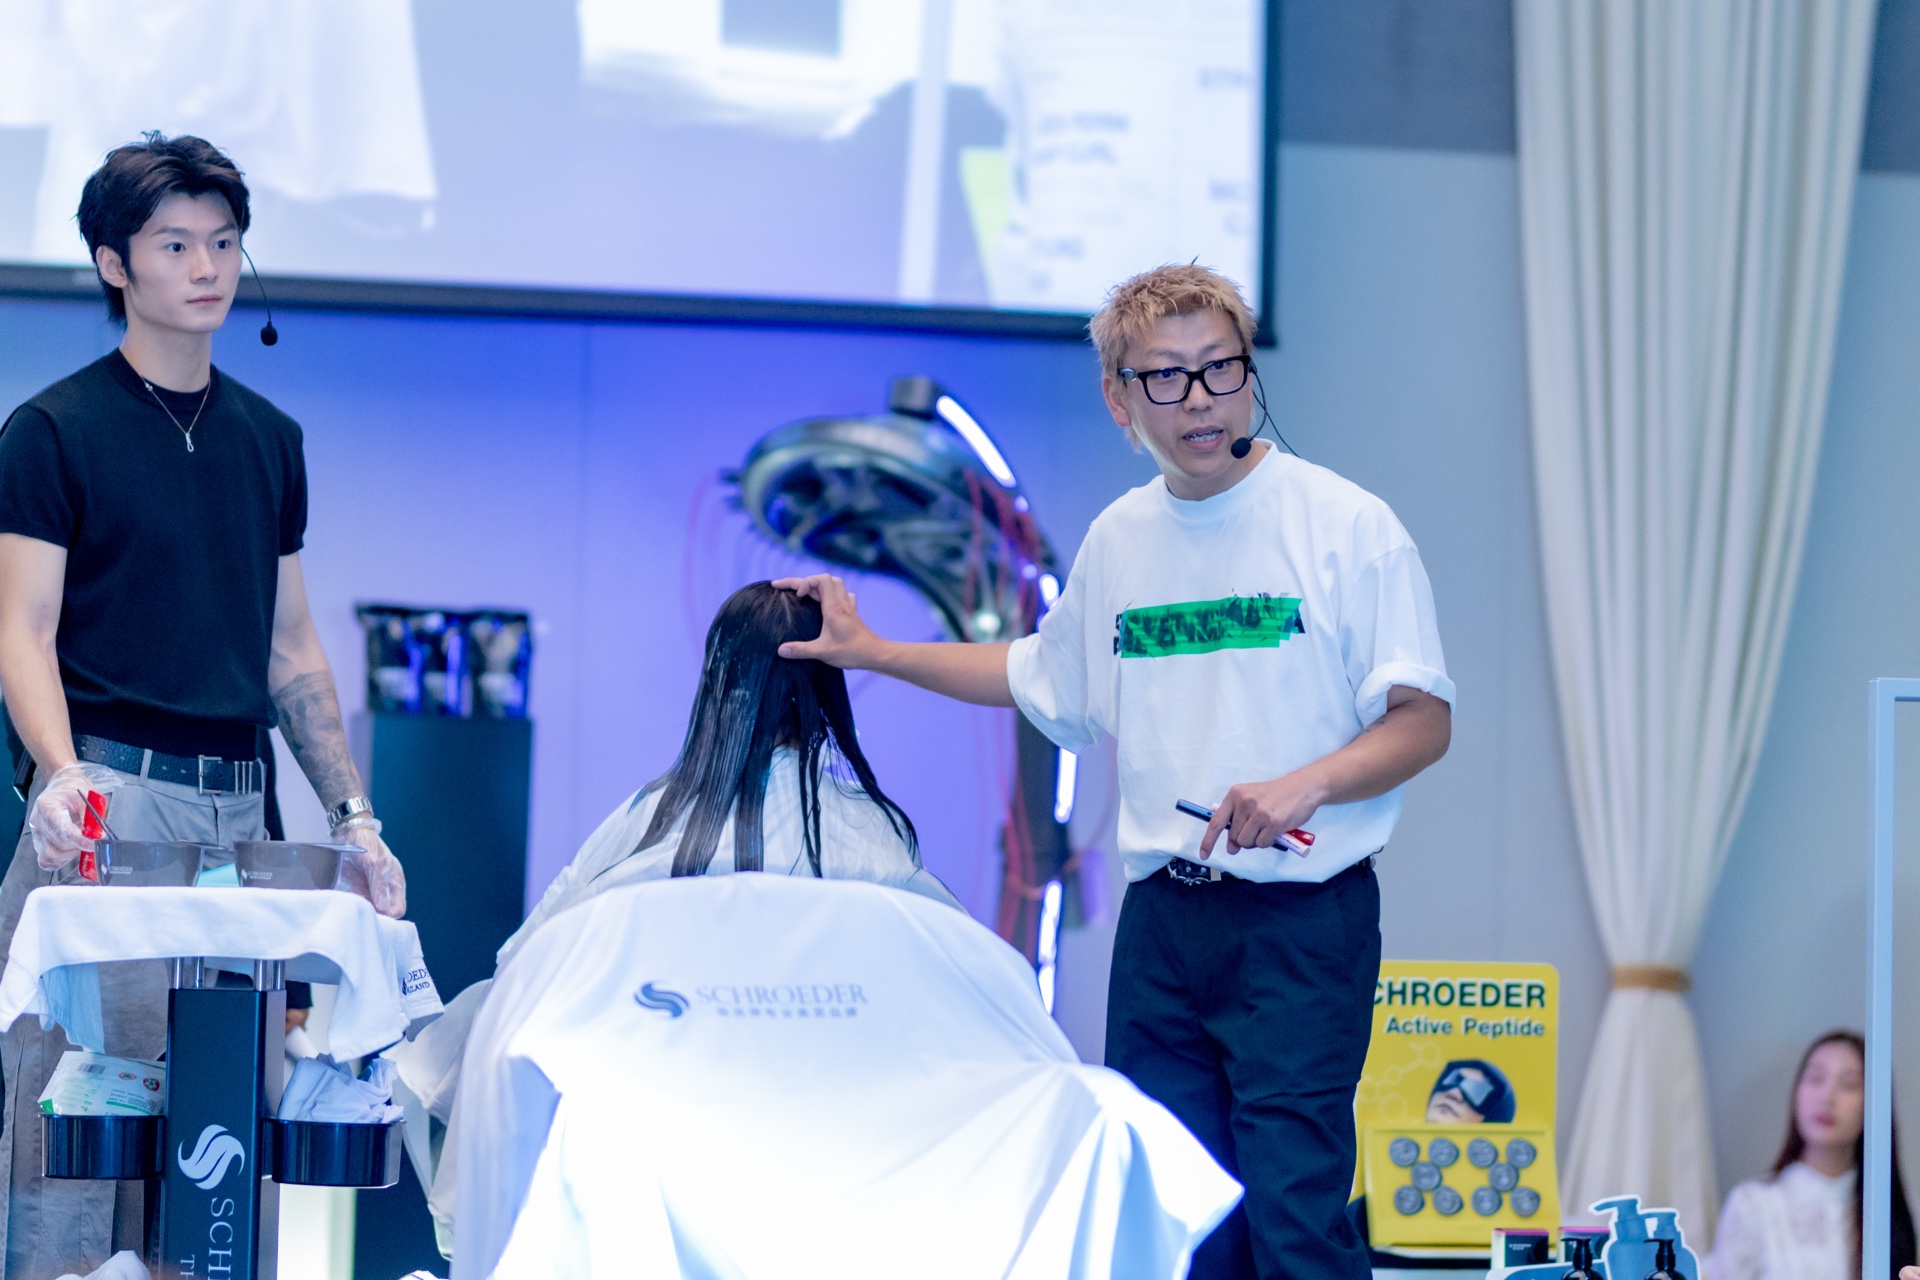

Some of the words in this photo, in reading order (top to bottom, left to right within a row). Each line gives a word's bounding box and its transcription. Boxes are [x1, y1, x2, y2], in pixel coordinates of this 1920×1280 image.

[695, 983, 868, 1006] SCHROEDER
[1386, 1016, 1453, 1034] Active
[1463, 1016, 1545, 1039] Peptide
[208, 1197, 235, 1280] SCH
